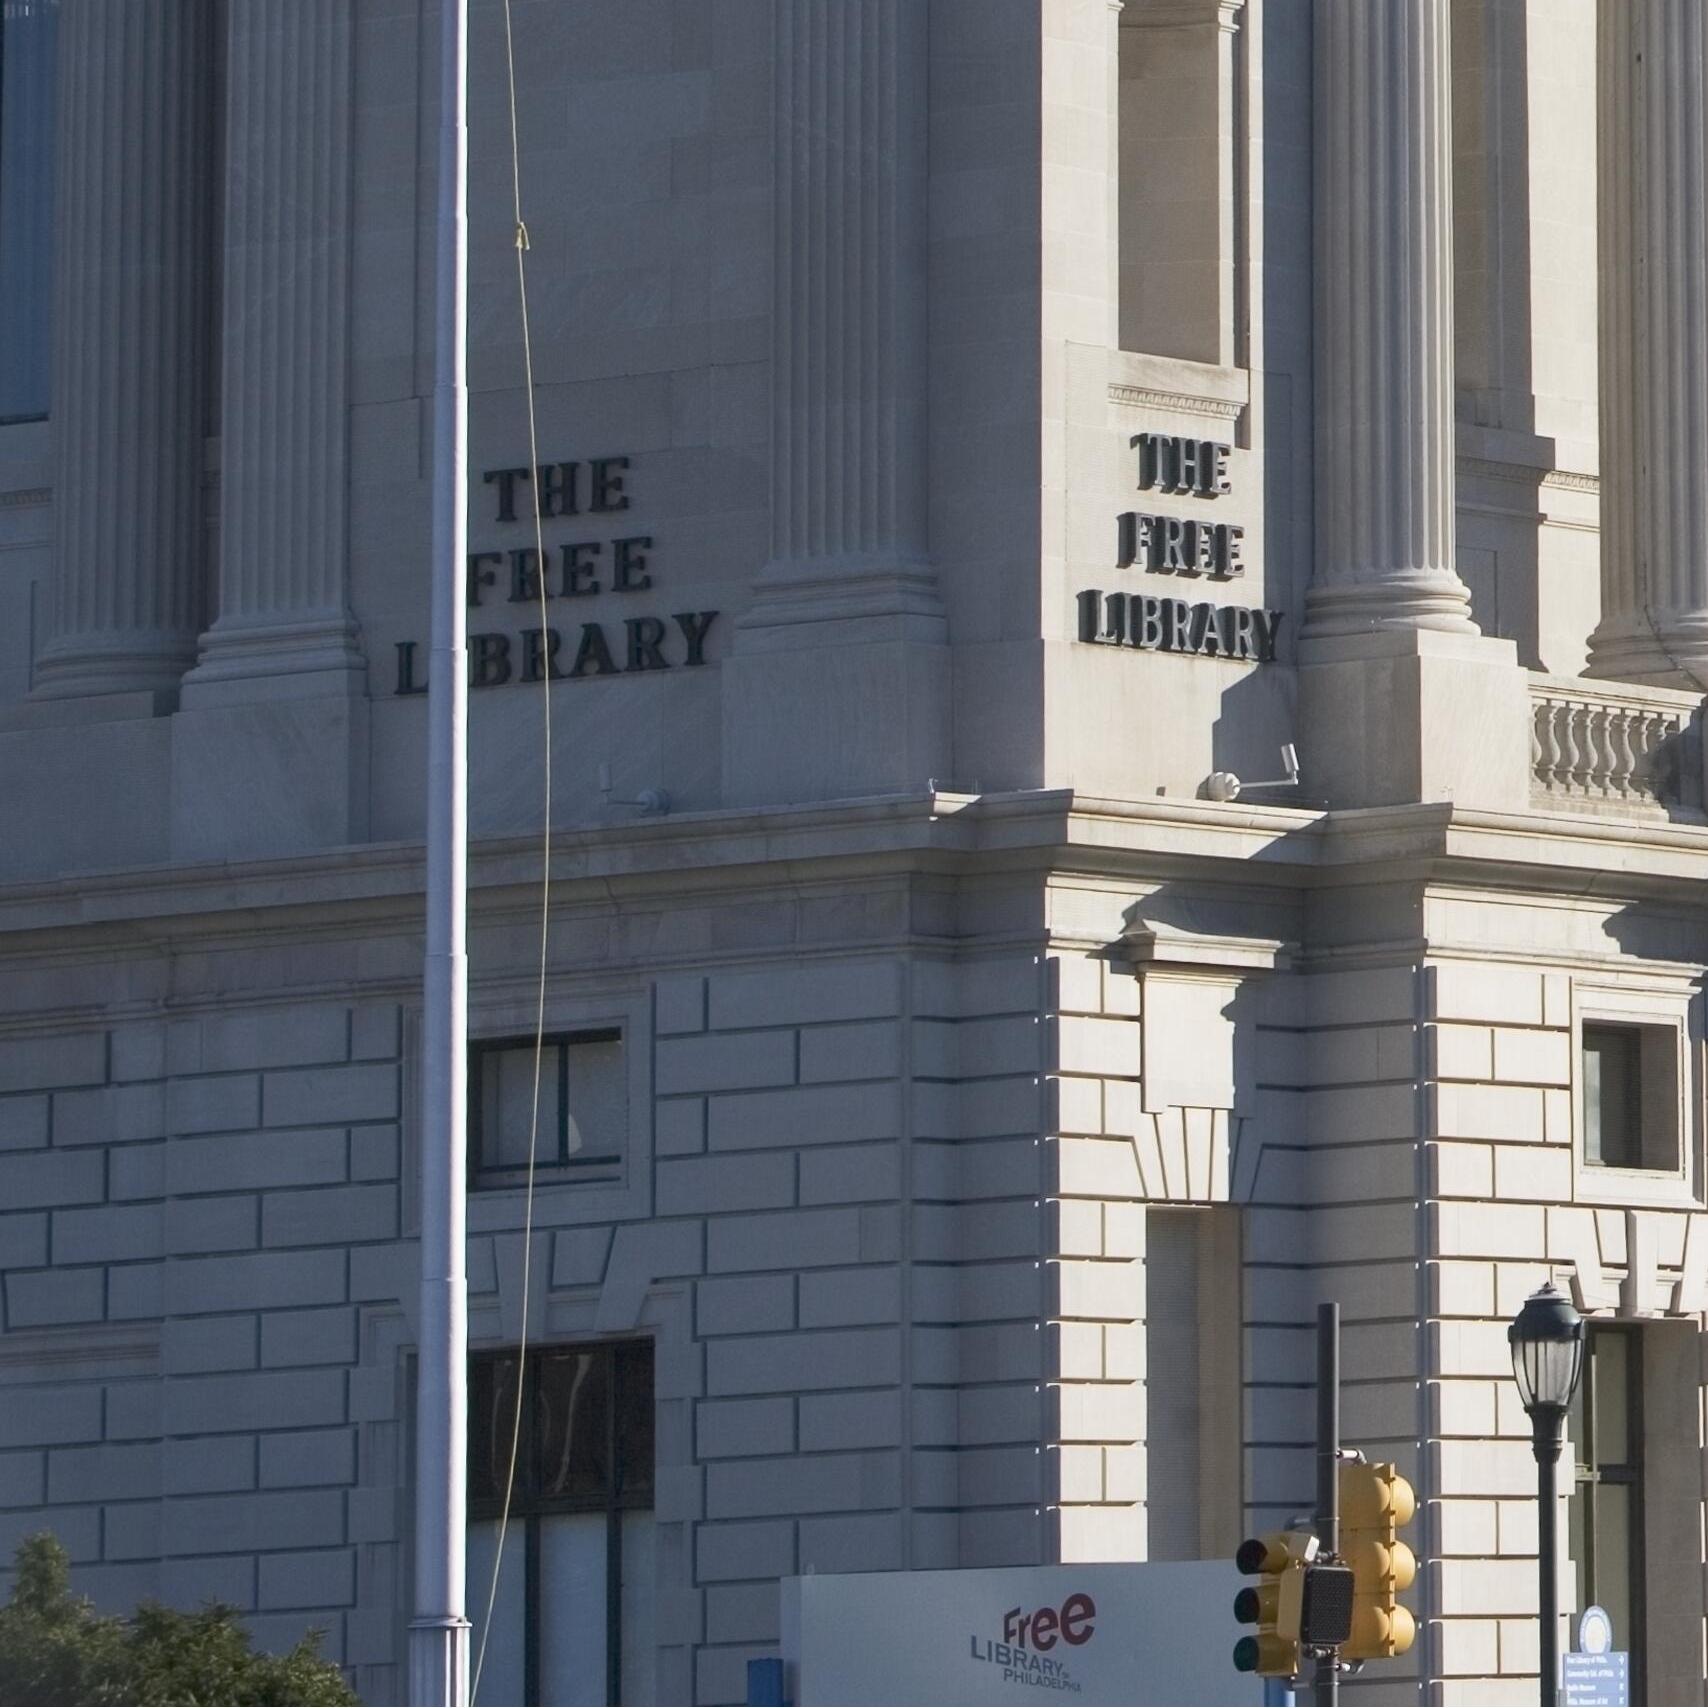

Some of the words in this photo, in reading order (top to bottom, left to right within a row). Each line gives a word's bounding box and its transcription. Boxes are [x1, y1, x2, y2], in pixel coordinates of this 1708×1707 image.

[483, 456, 630, 523] THE
[1131, 432, 1232, 498] THE
[467, 536, 653, 607] FREE
[1117, 511, 1245, 581] FREE
[394, 610, 720, 695] LBRARY
[1077, 589, 1284, 661] LIBRARY
[1003, 1593, 1096, 1651] Free
[970, 1635, 1063, 1678] LIBRARY
[1003, 1667, 1082, 1693] PHILADELPHIA
